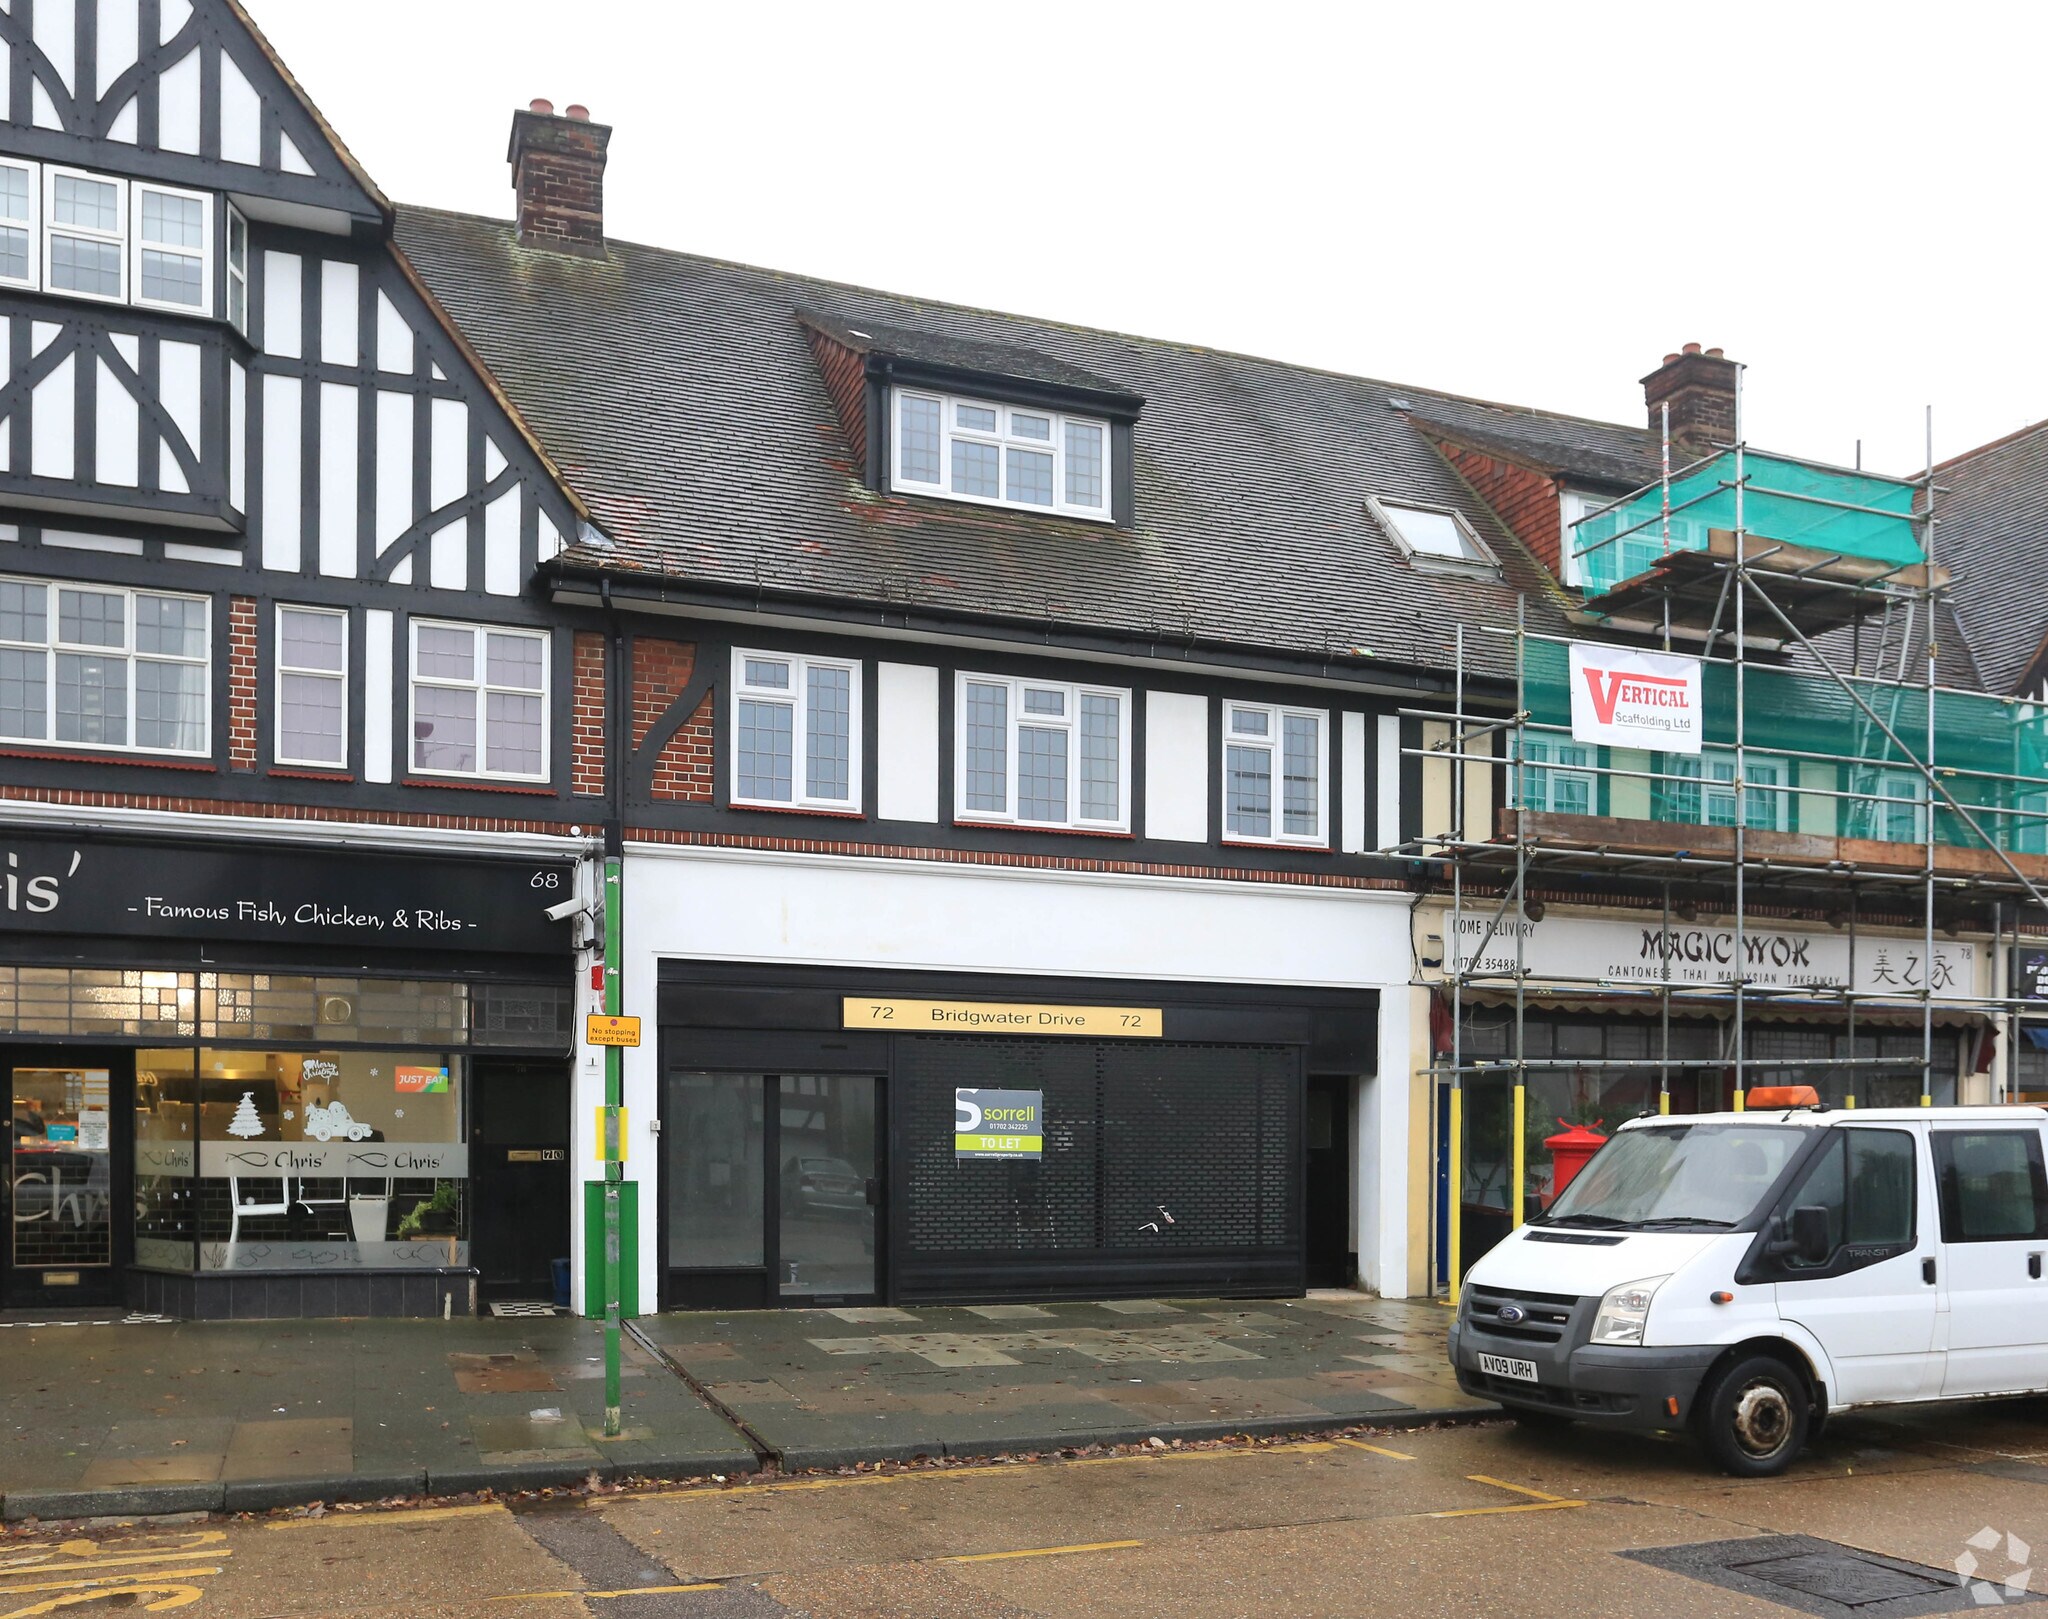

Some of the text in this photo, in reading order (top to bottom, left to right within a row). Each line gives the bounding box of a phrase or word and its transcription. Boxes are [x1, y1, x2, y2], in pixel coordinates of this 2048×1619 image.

[1582, 667, 1689, 724] VERTICAL
[1615, 711, 1690, 729] Scaffolding Ltd
[0, 850, 81, 912] is'
[530, 871, 559, 888] 68
[145, 896, 230, 920] Famous
[236, 900, 287, 926] Fish,
[294, 902, 385, 931] Chicken,
[392, 909, 409, 928] &
[415, 909, 461, 931] Ribs
[1640, 928, 1810, 968] MAGIC WOK
[1961, 948, 1972, 960] 78
[1453, 957, 1518, 971] 172 35488
[1870, 948, 1956, 990] 美之家
[1608, 965, 1672, 980] CANTONESE
[1683, 969, 1707, 980] THAI
[1787, 974, 1840, 986] TAKEAWAY
[870, 1006, 1142, 1028] 72 Bridgwater Drive 72
[604, 1028, 636, 1036] stopping
[399, 1075, 444, 1084] JUST EAT
[984, 1106, 1034, 1121] sorrell
[1007, 1123, 1028, 1131] 342225
[980, 1137, 1021, 1149] TO LET
[164, 1153, 192, 1167] Chris'
[274, 1150, 328, 1169] Chris'
[394, 1152, 444, 1170] Chris'
[543, 1150, 563, 1160] 70
[1848, 1249, 1889, 1257] TRANSIT
[1483, 1355, 1533, 1378] AV09 URH
